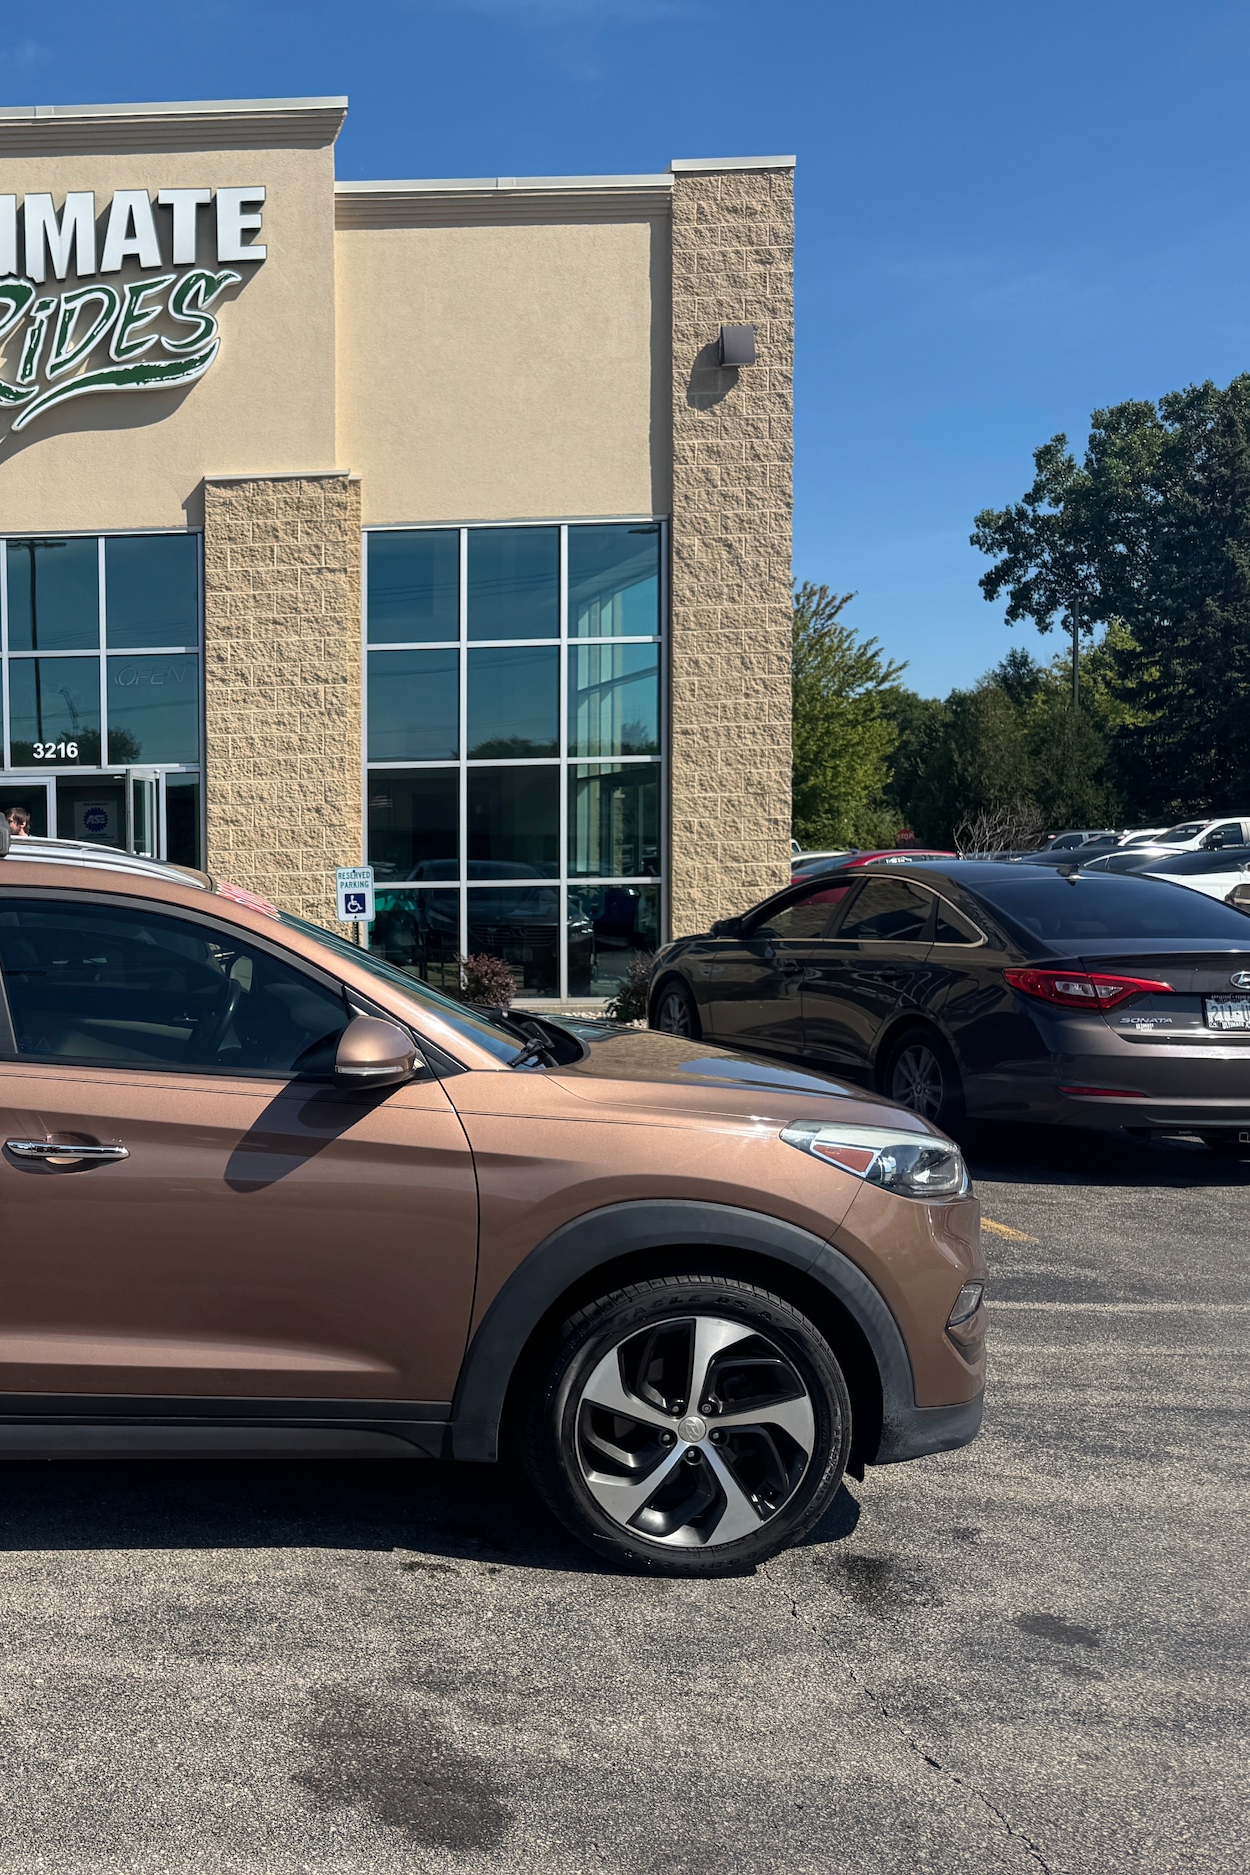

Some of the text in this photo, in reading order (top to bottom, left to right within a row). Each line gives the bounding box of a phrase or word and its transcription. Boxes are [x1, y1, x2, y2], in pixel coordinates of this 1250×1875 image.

[32, 741, 79, 759] 3216
[86, 814, 106, 825] ASE
[338, 871, 370, 880] RESERVED
[340, 881, 369, 889] PARKING
[1211, 1005, 1250, 1023] 211-U
